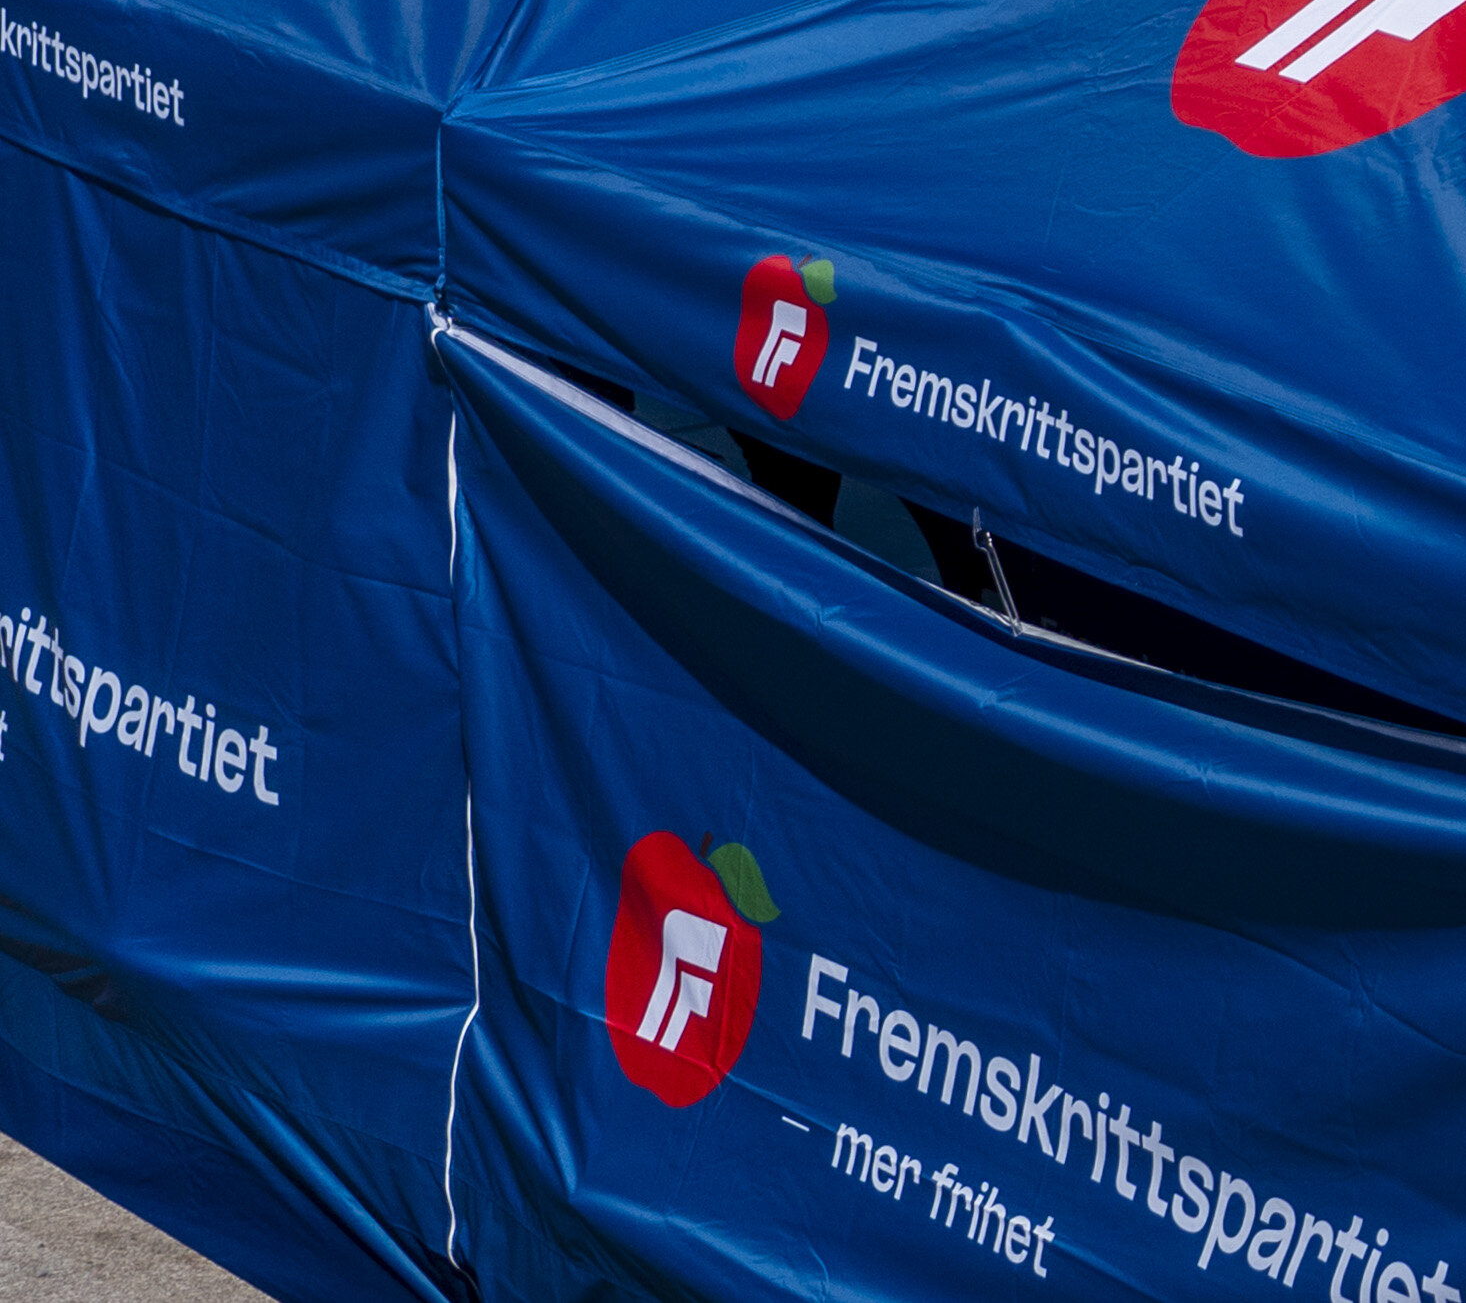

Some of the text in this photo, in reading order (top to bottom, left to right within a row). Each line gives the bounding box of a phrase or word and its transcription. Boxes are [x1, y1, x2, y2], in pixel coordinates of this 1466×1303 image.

[843, 336, 1245, 537] Fremskrittspartiet
[800, 953, 1463, 1303] Fremskrittspartiet
[831, 1123, 922, 1201] mer
[929, 1162, 1056, 1279] frihet
